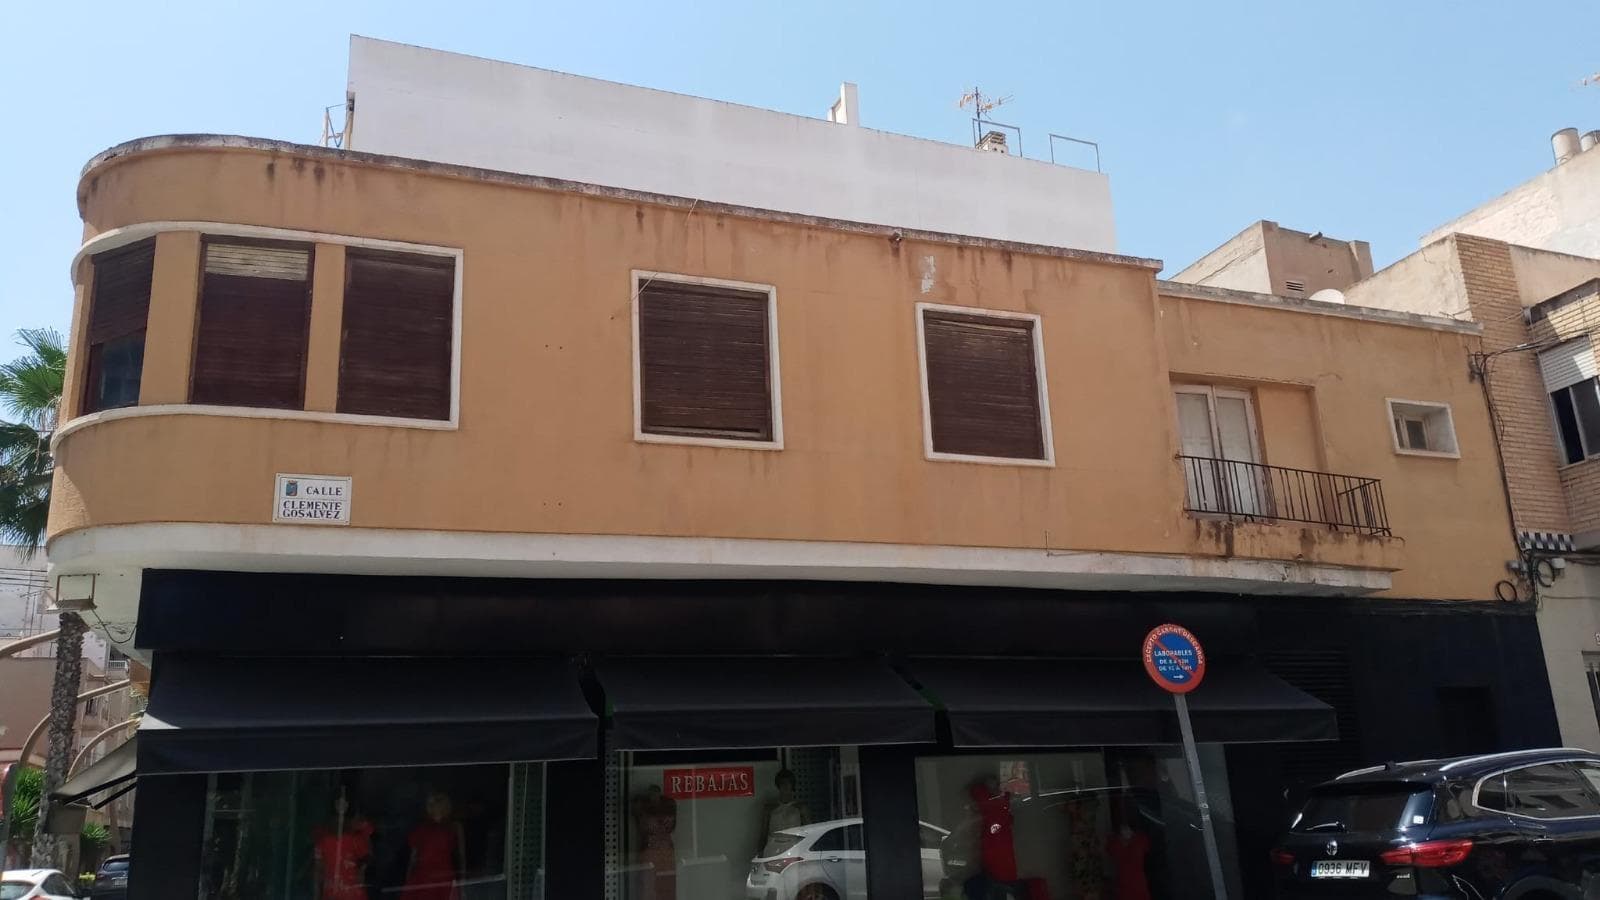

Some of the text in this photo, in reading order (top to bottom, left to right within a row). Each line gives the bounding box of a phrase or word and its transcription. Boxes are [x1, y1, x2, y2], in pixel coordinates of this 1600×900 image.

[306, 486, 342, 496] CALLE
[283, 500, 342, 510] CLEMENTE
[282, 509, 340, 519] GOSALVEZ
[1154, 649, 1193, 657] LABORABLES
[672, 773, 749, 793] REBAJAS
[1318, 862, 1342, 875] 0936
[1345, 862, 1367, 874] MFV
